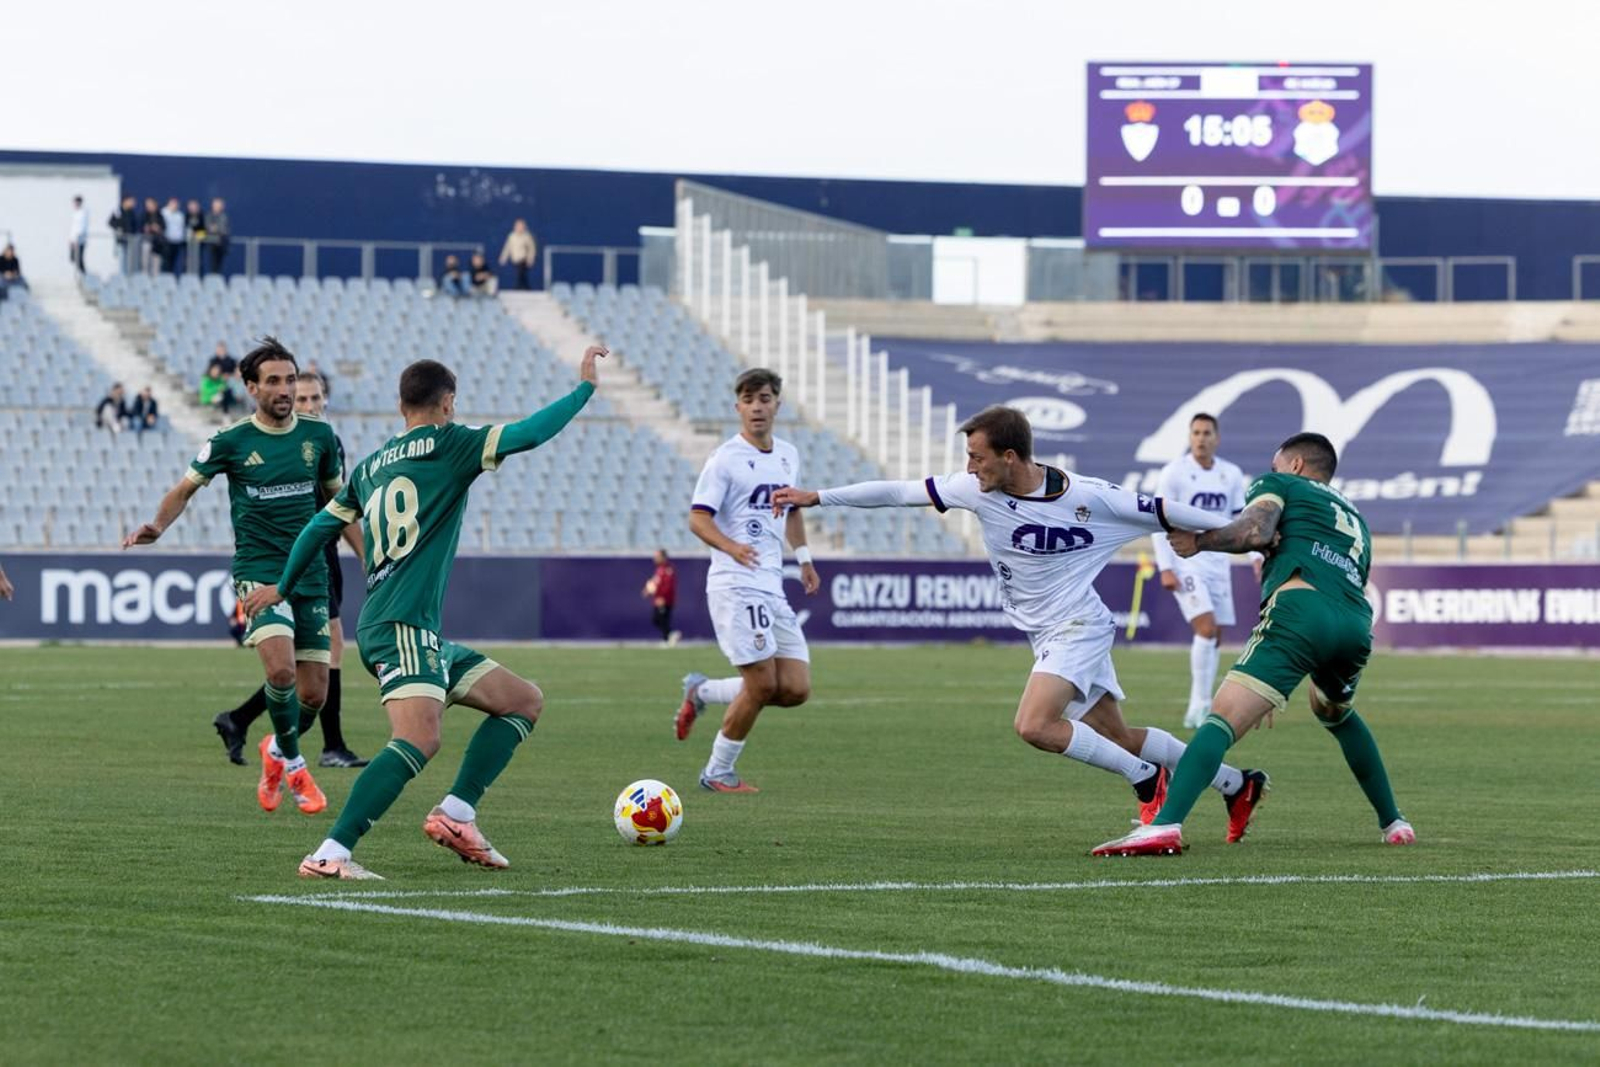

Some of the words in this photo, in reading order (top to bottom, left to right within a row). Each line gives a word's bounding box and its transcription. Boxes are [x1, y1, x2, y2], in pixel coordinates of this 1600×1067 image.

[1184, 114, 1273, 147] 15:05
[1181, 184, 1204, 216] 0
[1253, 184, 1276, 216] 0
[364, 476, 420, 567] 18
[1330, 502, 1365, 565] 4
[831, 574, 910, 609] GAYZU
[915, 575, 1004, 609] RENOV
[1385, 588, 1540, 623] ENERDRINK
[746, 605, 770, 629] 16
